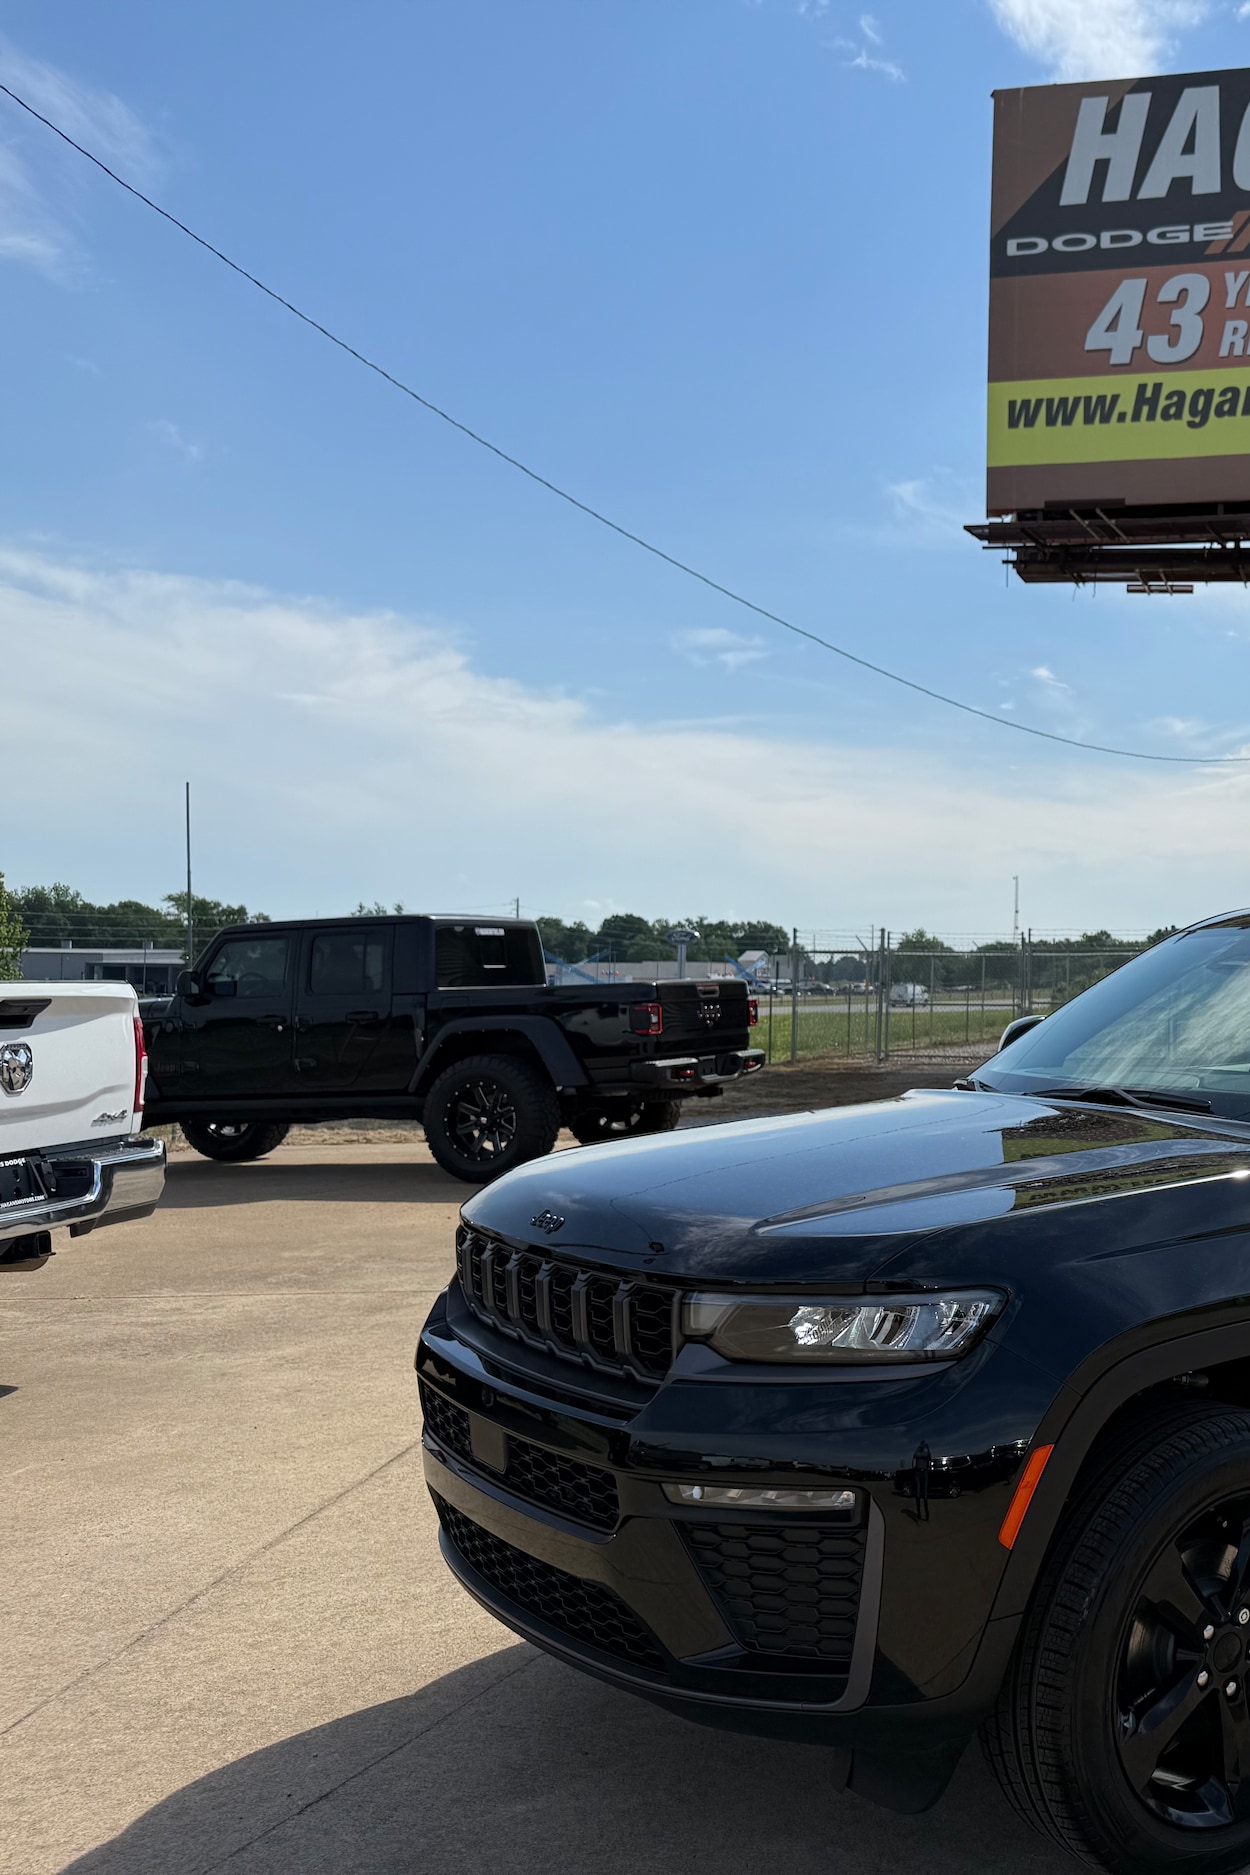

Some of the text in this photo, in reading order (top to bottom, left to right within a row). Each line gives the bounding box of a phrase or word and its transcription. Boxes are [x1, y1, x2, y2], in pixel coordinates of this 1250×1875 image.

[1006, 220, 1234, 257] DODGE
[1083, 273, 1210, 366] 43
[529, 1208, 566, 1235] Jeep
